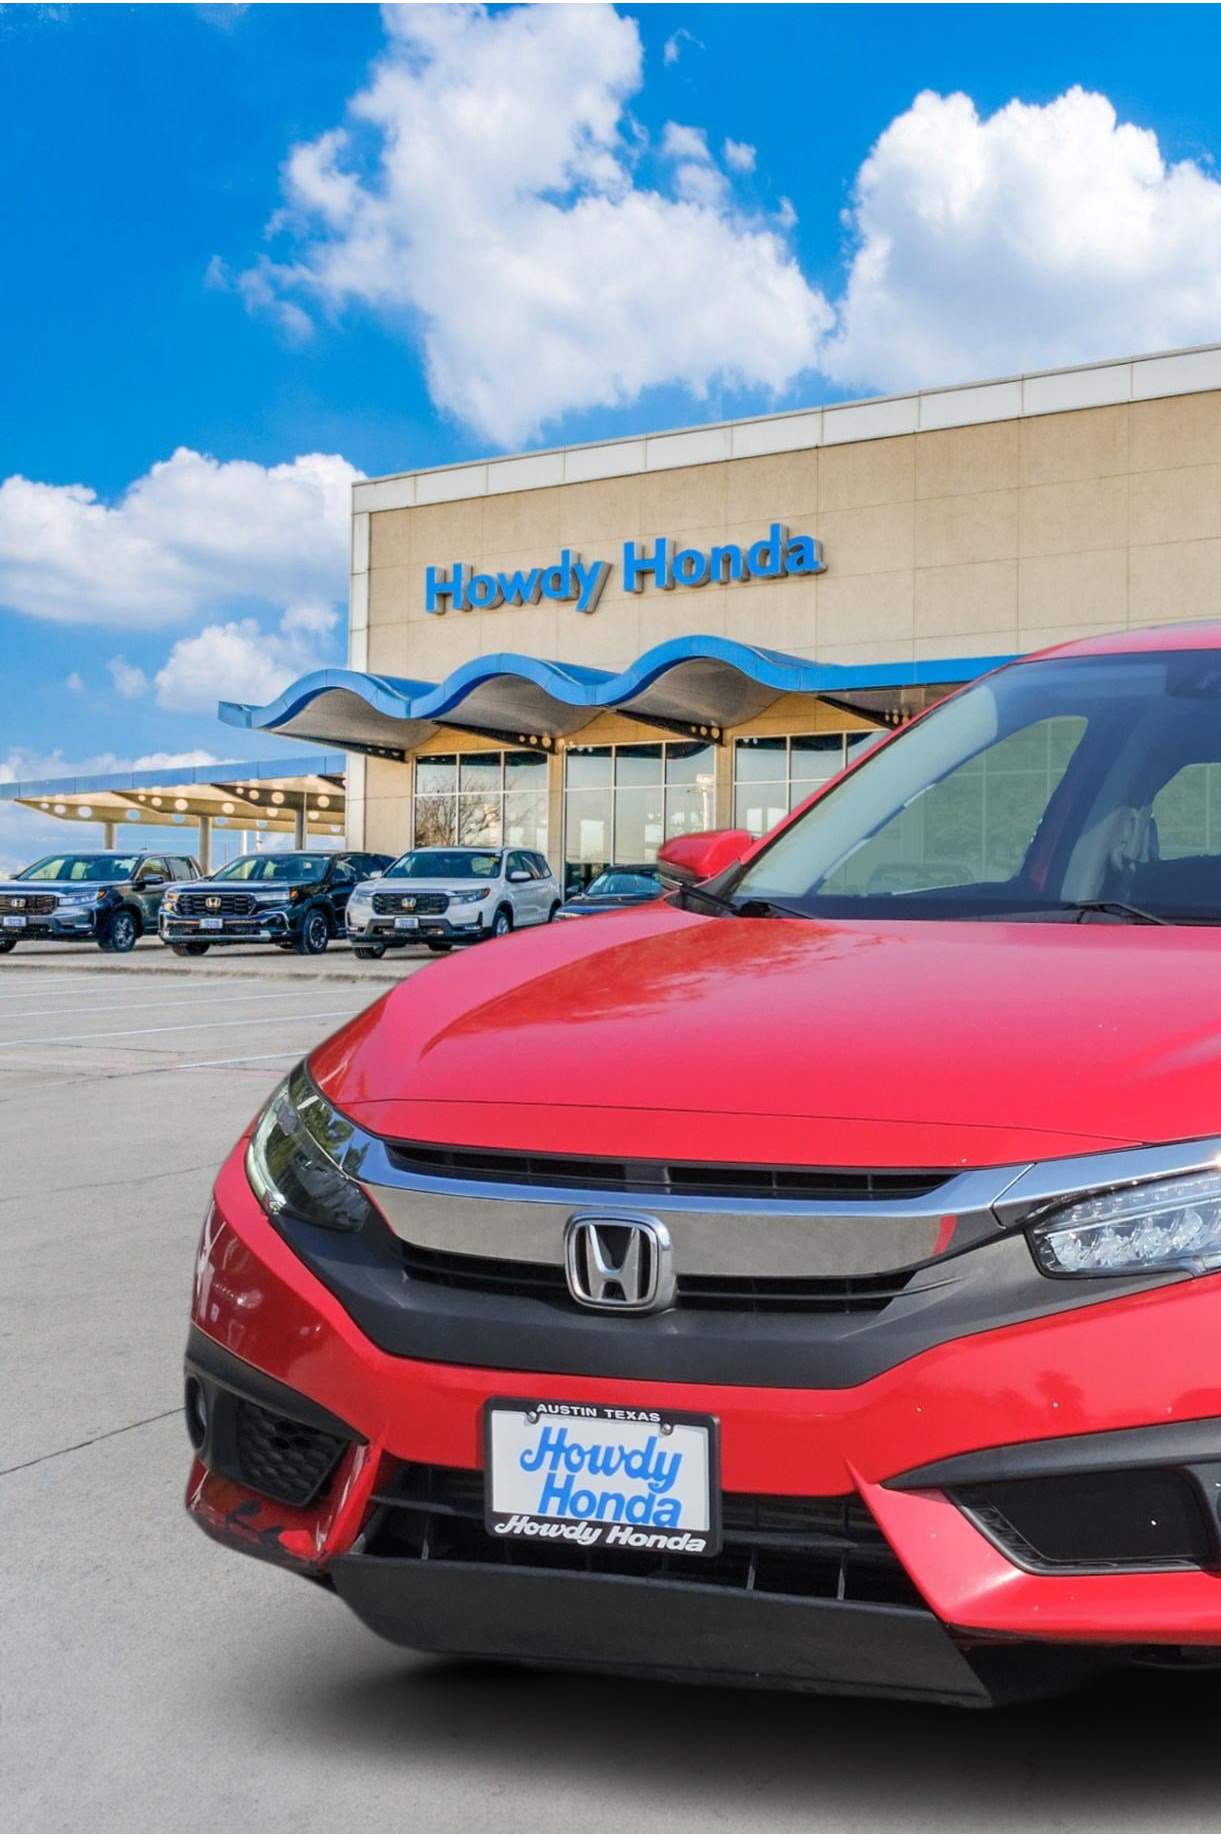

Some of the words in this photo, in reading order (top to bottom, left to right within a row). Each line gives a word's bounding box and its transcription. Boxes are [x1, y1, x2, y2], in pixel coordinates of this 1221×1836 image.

[425, 549, 611, 614] Howdy
[623, 523, 826, 593] Honda
[536, 1403, 598, 1417] AUSTIN
[604, 1409, 661, 1422] TEXAS
[520, 1426, 682, 1494] Howdy
[538, 1472, 682, 1529] Honda
[495, 1515, 602, 1546] Howdy
[606, 1525, 706, 1552] Honda
